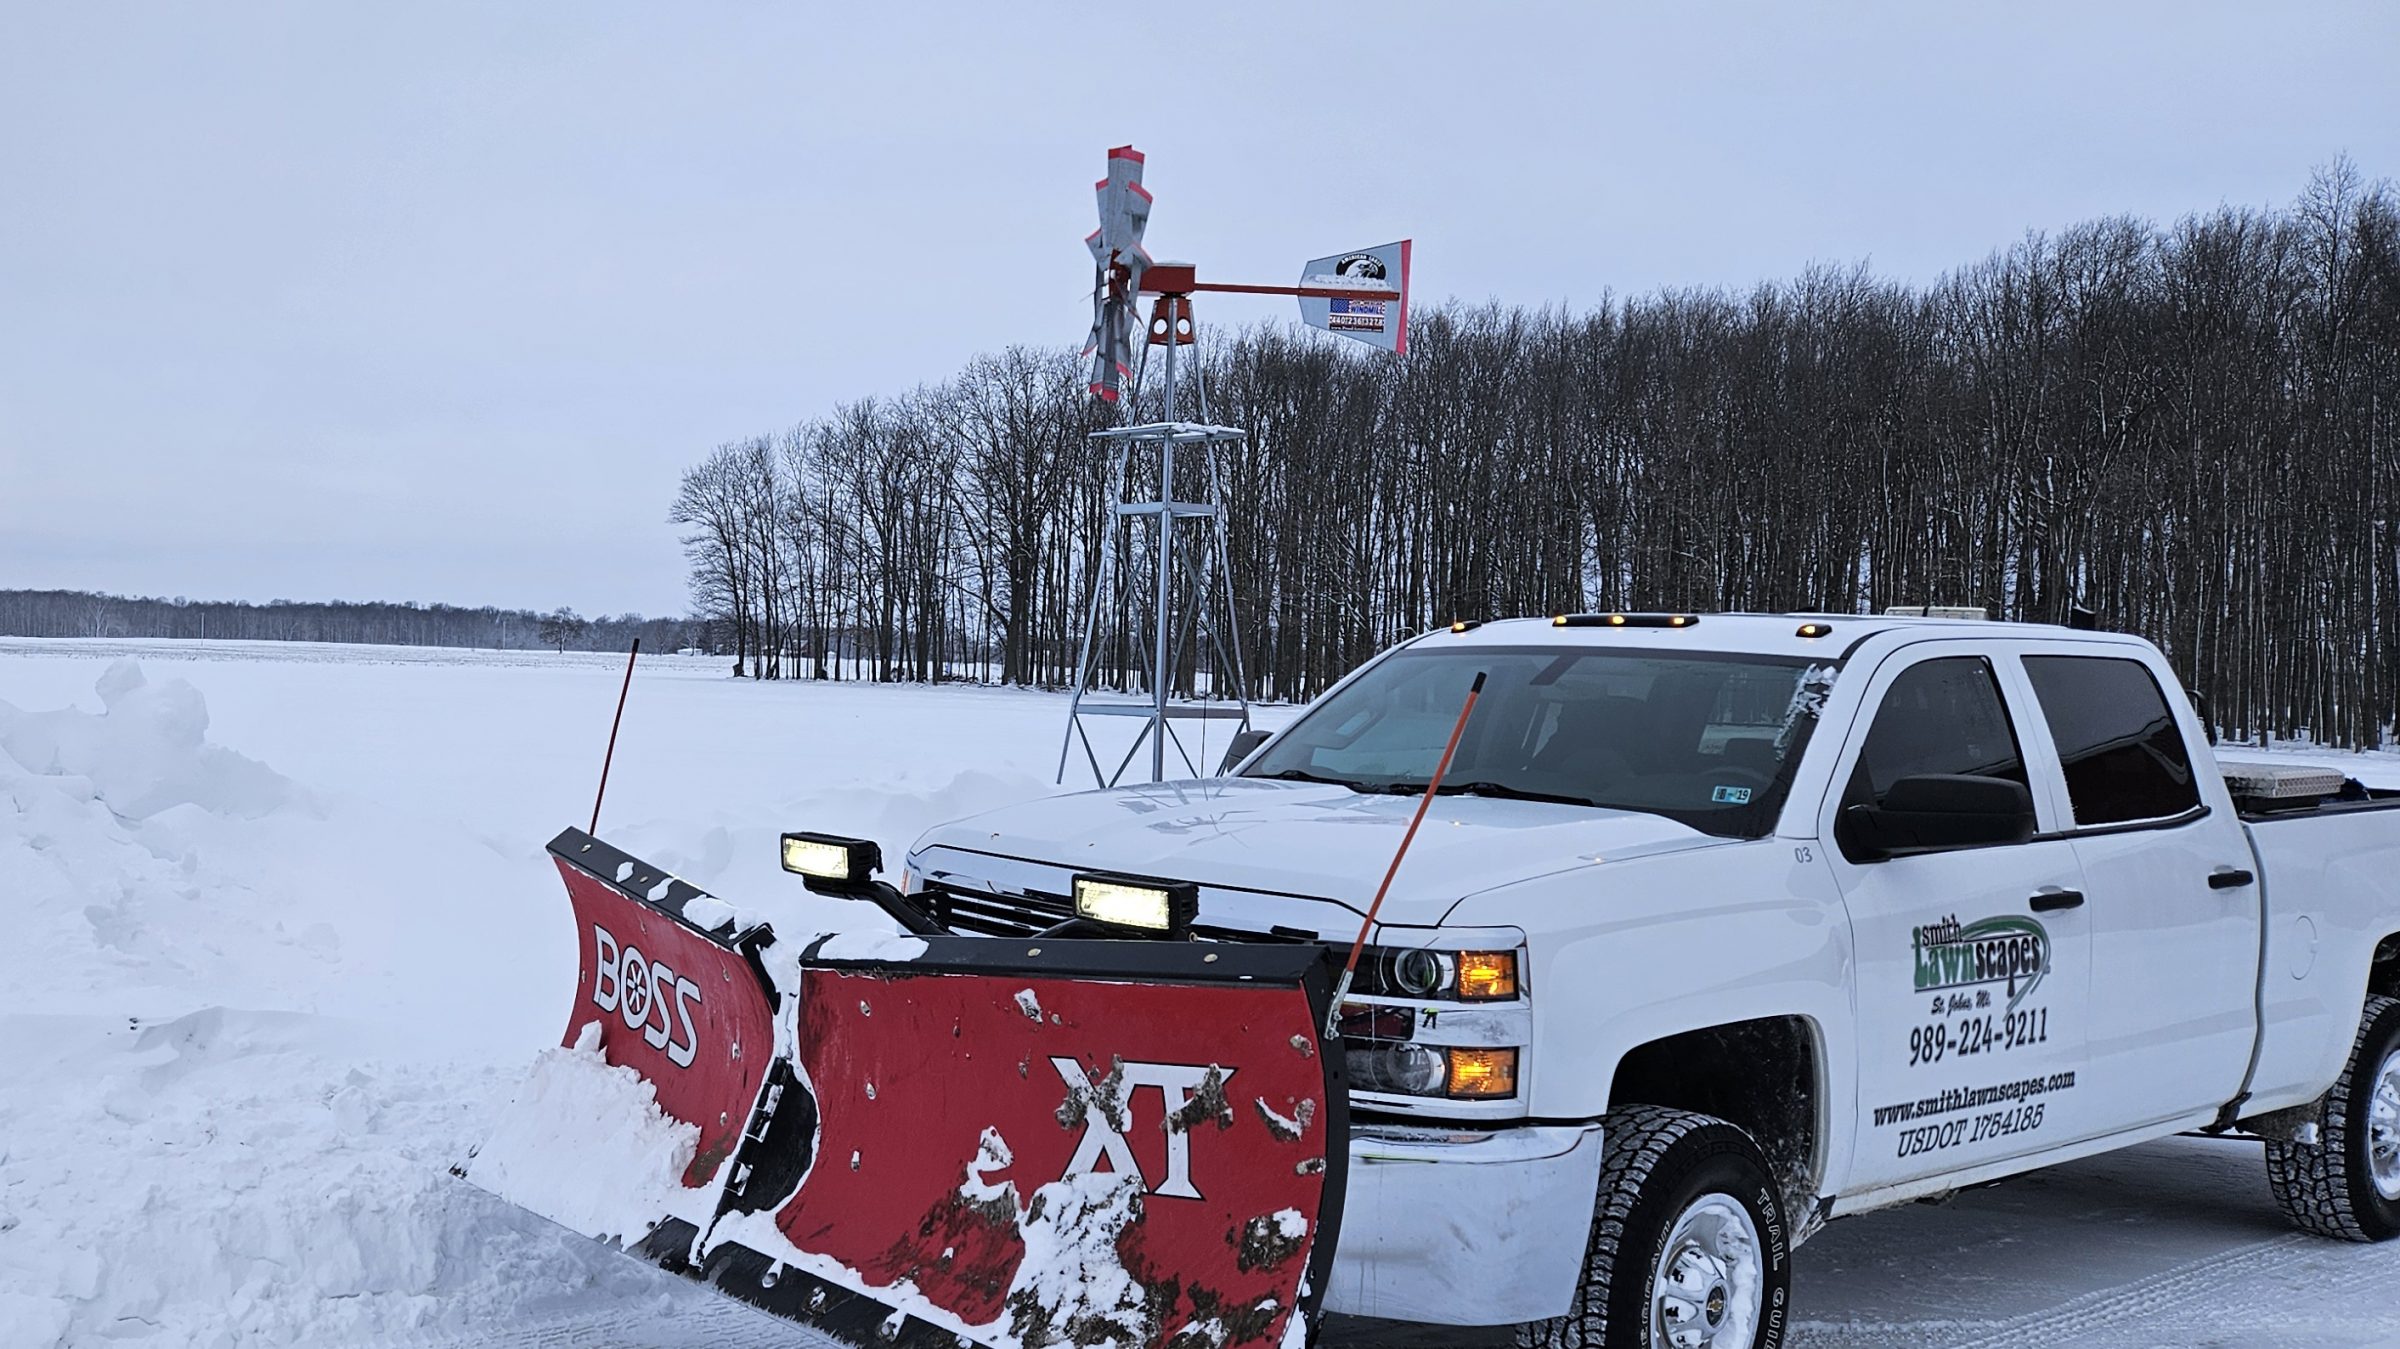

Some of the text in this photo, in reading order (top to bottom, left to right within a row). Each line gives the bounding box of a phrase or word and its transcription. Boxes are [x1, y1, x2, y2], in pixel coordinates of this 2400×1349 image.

[1736, 789, 1749, 801] 19
[1794, 846, 1813, 864] 03
[1922, 913, 1963, 946] smith
[593, 923, 702, 1069] BOSS
[1909, 1006, 2048, 1067] 989-224-9211
[1873, 1070, 2076, 1127] www.smithlawnscapes.com
[1048, 1055, 1239, 1202] XT
[1897, 1103, 2046, 1158] USDOT 1754185
[1757, 1187, 1785, 1272] TRAIL
